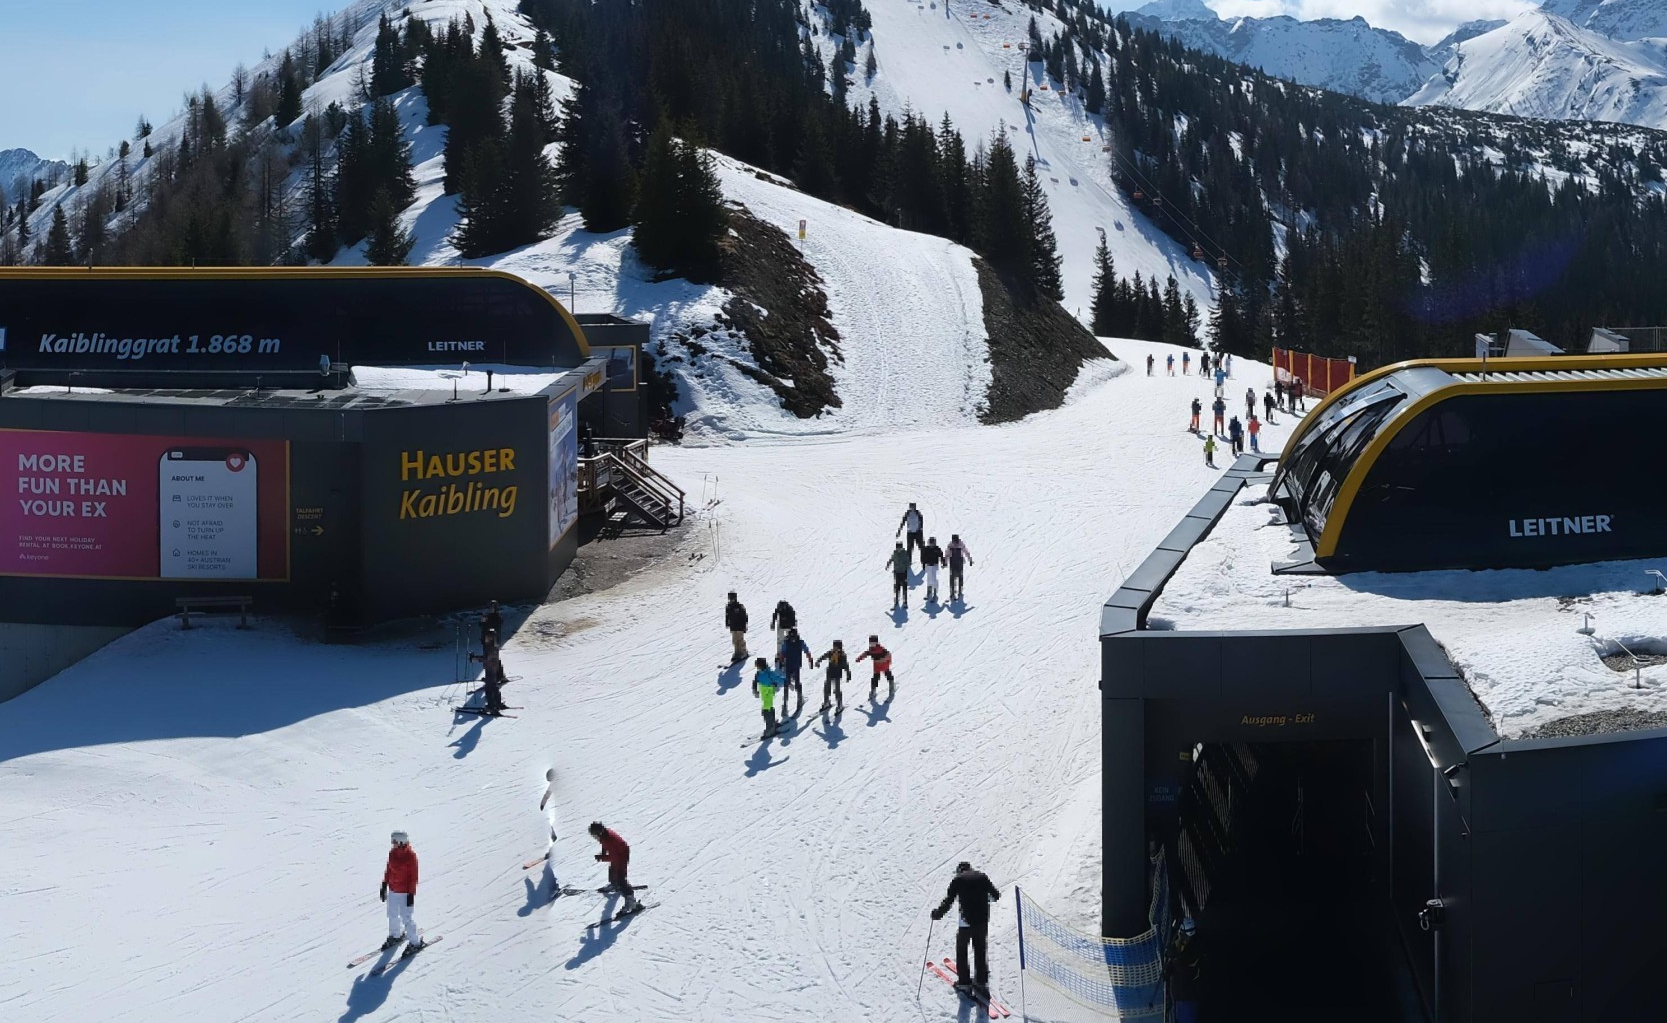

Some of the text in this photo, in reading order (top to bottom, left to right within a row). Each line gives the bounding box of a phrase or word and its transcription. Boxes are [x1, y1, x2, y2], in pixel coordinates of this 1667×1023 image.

[39, 333, 281, 360] Kaiblinggrat 1.868 m
[428, 340, 485, 352] LEITNER
[18, 454, 85, 473] MORE
[401, 448, 516, 482] HAUSER
[18, 477, 127, 496] FUN THAN
[20, 499, 108, 518] YOUR EX
[399, 481, 518, 520] Kaibling
[1509, 514, 1613, 538] LEITNER
[1241, 715, 1286, 727] Ausgang
[1295, 713, 1315, 723] Exit
